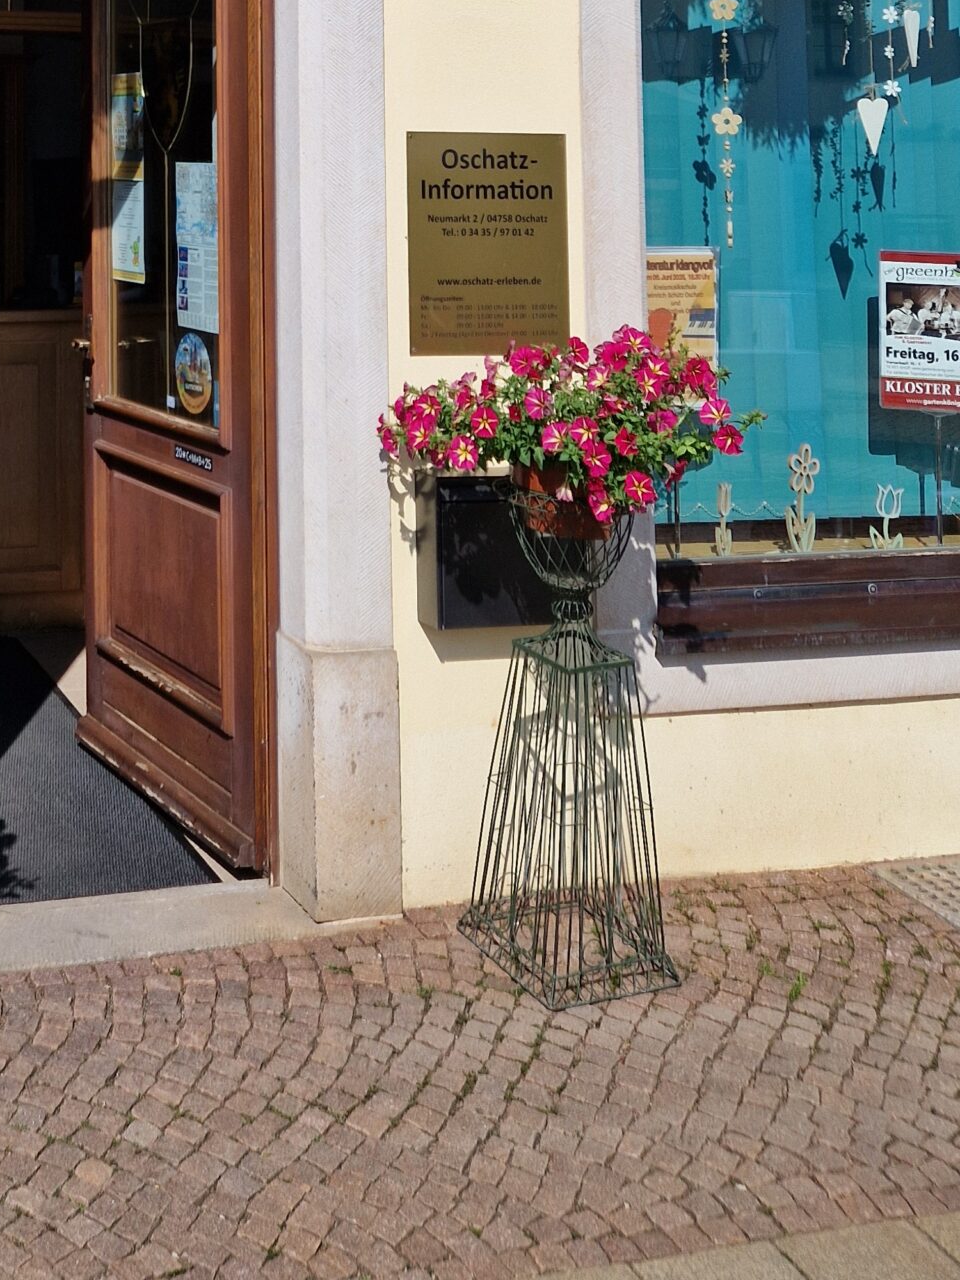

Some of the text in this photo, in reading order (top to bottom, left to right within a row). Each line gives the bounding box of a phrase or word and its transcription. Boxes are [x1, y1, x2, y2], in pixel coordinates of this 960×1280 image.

[441, 148, 538, 170] Oschatz-
[421, 178, 554, 200] Information
[427, 214, 471, 224] Neumarkt
[473, 214, 478, 223] 2
[487, 214, 513, 224] 04758
[515, 214, 548, 224] Oschatz
[442, 228, 460, 237] Tel.:
[461, 228, 467, 237] 0
[468, 228, 479, 237] 34
[480, 228, 491, 237] 35
[500, 228, 511, 237] 97
[512, 228, 522, 237] 01
[524, 228, 535, 237] 42
[437, 276, 542, 287] www.oschatz-erleben.de
[885, 346, 939, 364] Freitag,
[885, 380, 952, 396] KLOSTER
